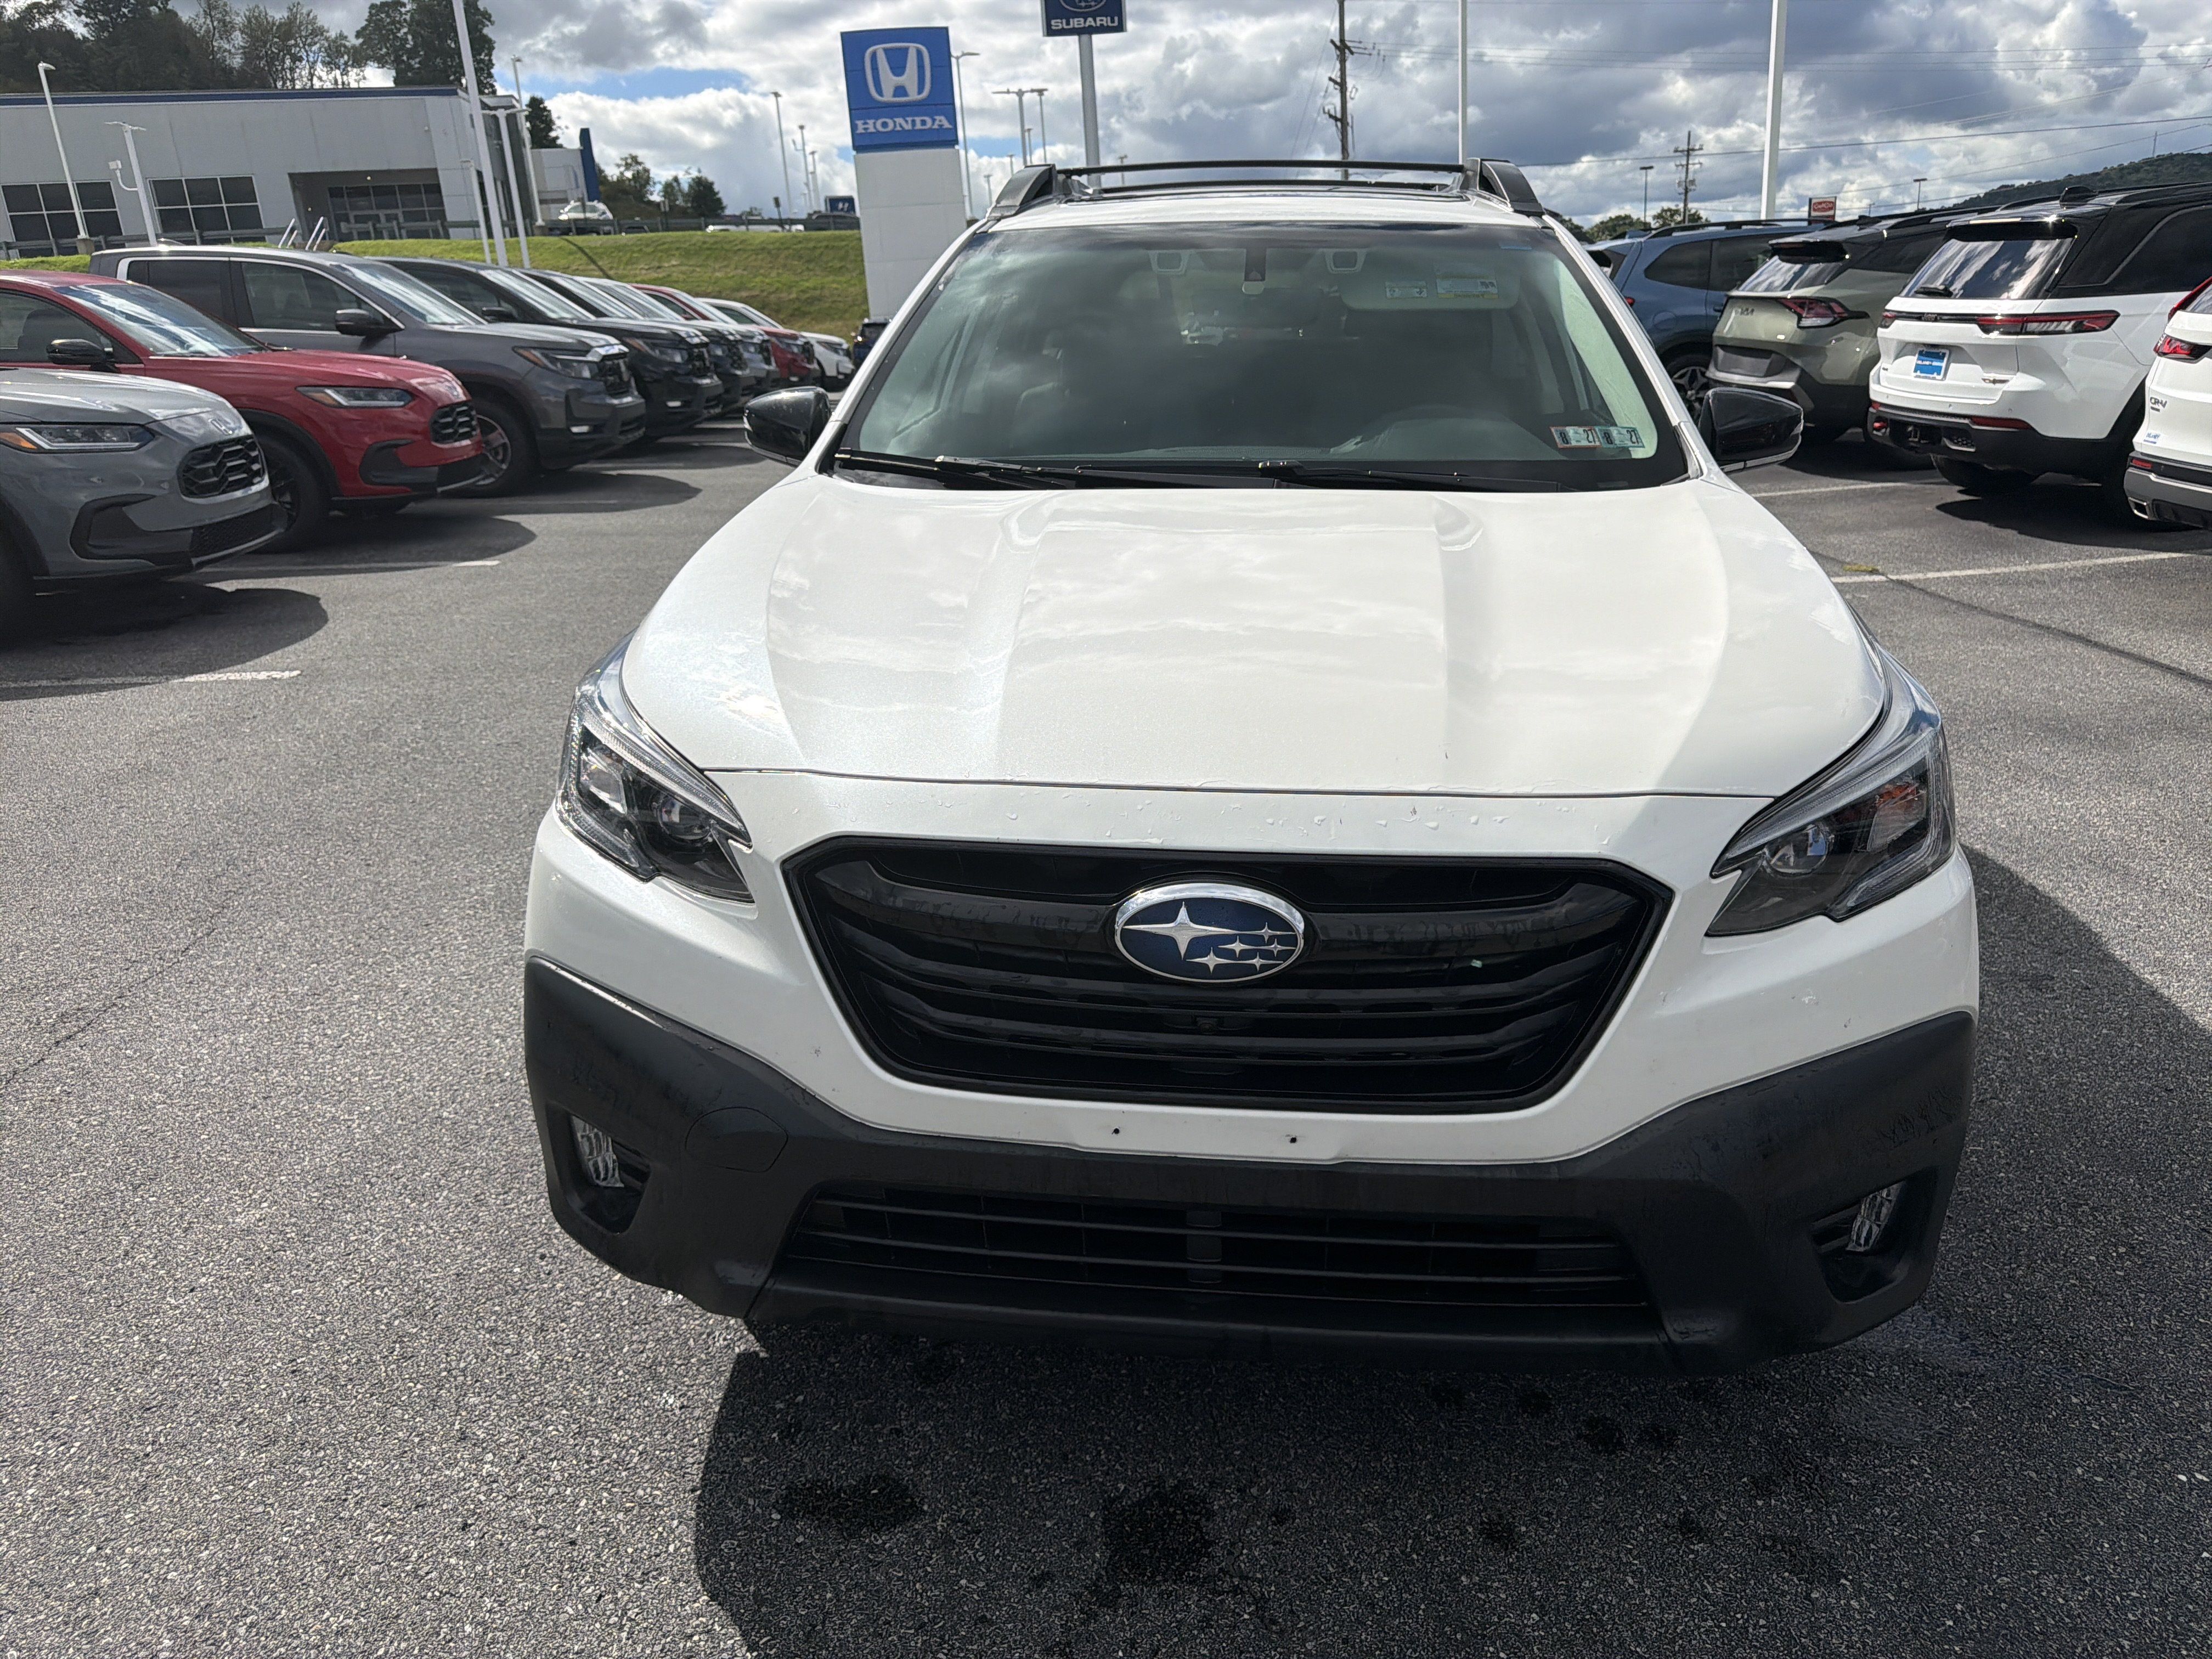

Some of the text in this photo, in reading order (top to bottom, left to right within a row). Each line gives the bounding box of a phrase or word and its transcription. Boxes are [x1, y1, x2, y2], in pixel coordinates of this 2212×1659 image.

[1051, 16, 1119, 30] SUBARU
[855, 116, 952, 133] HONDA
[2150, 397, 2167, 408] CR-V
[1560, 429, 1596, 444] 8 27
[1604, 430, 1639, 445] 8 27
